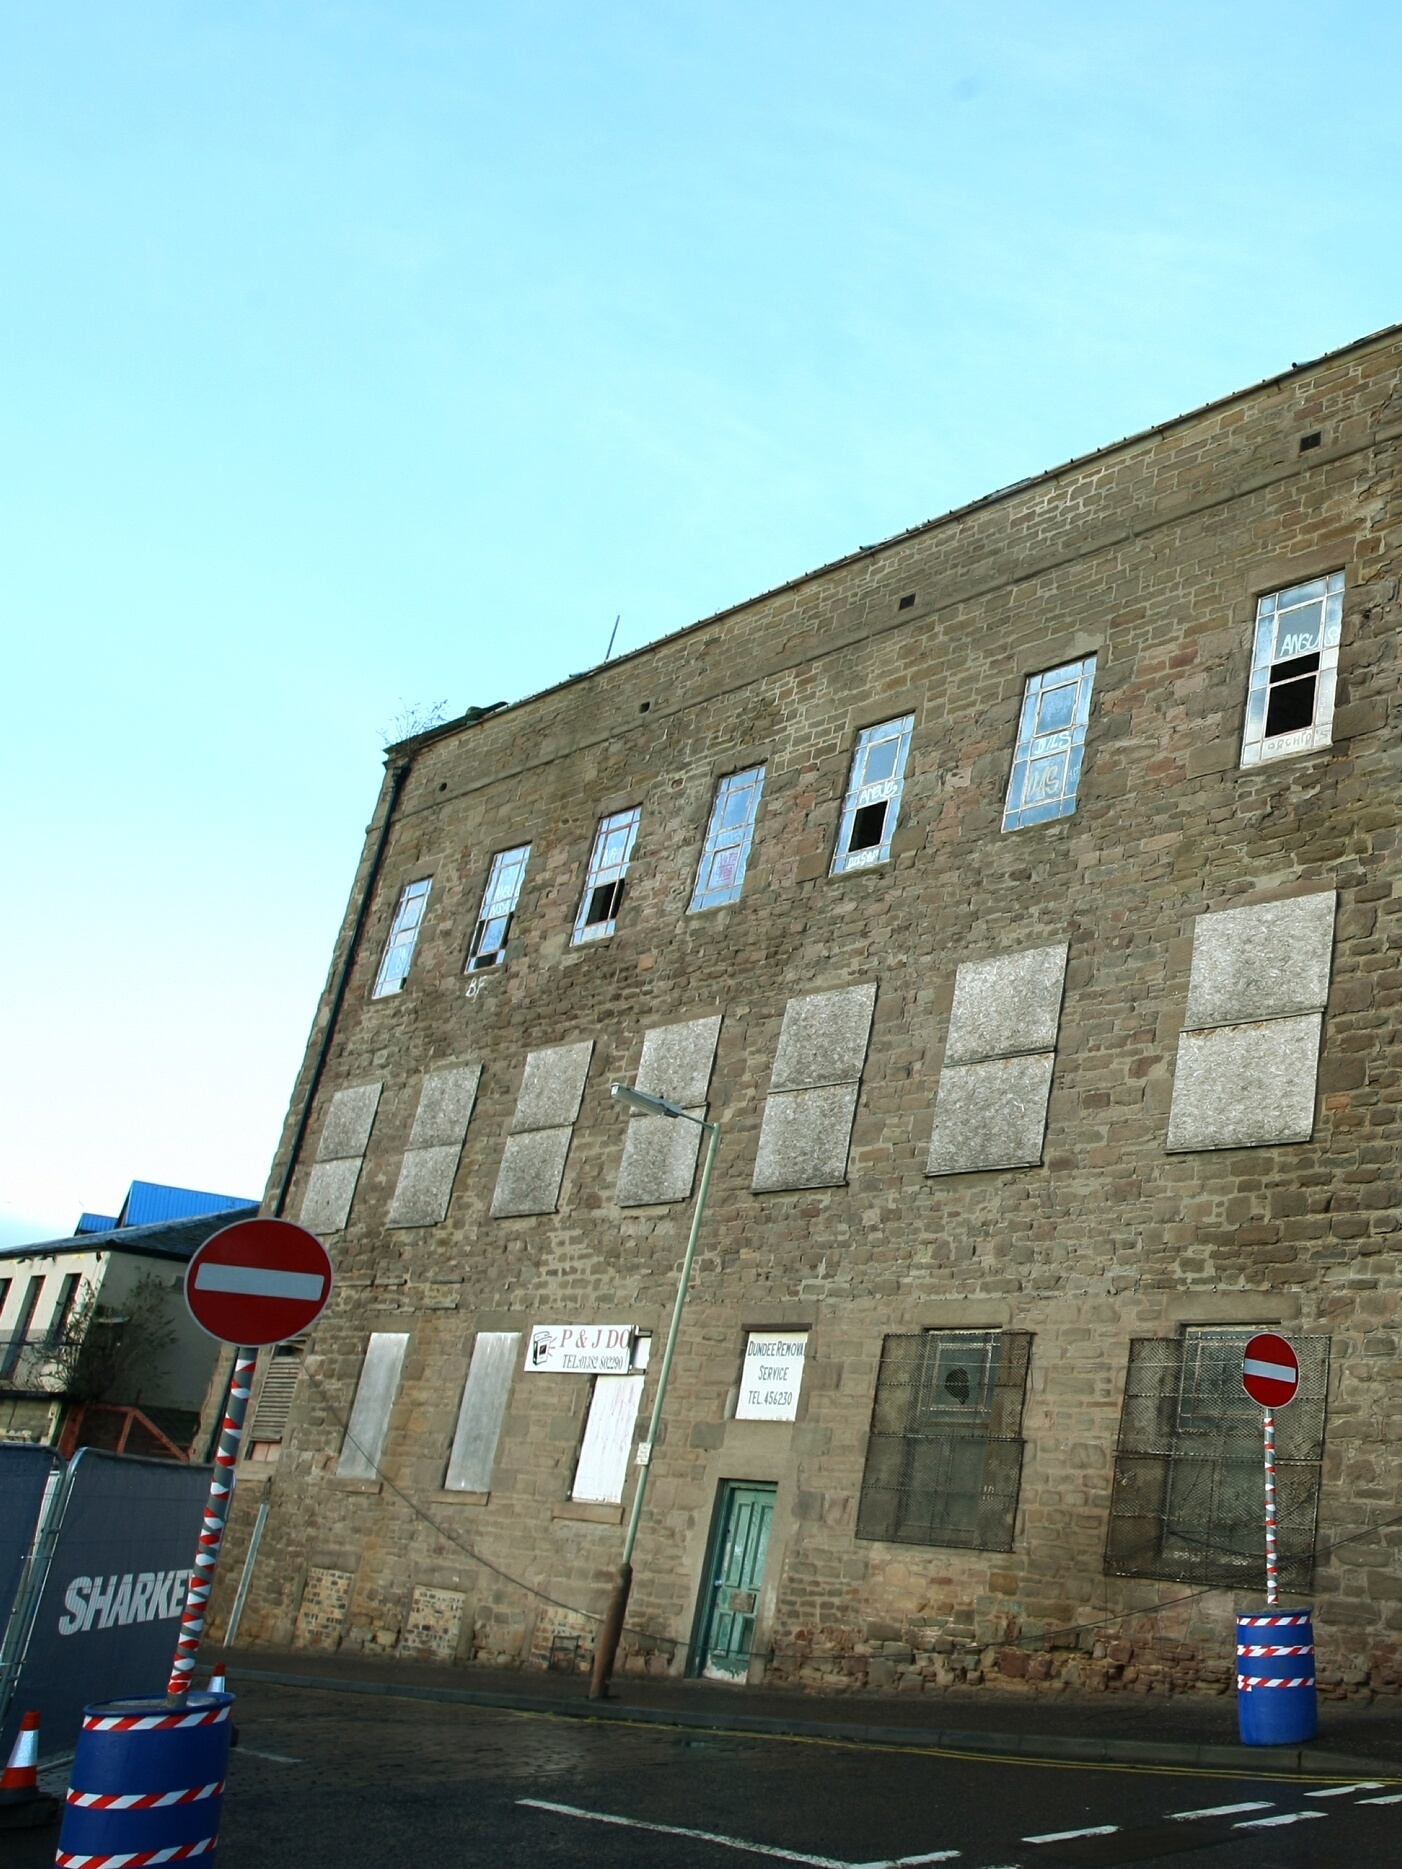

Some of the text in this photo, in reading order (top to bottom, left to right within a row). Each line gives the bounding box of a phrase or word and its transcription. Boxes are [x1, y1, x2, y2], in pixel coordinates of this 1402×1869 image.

[1280, 625, 1340, 656] ANGUS
[559, 1329, 573, 1348] P
[575, 1329, 588, 1349] &
[591, 1329, 603, 1349] J
[748, 1340, 777, 1356] DUNDEE
[758, 1365, 789, 1381] SERVICE
[764, 1391, 793, 1406] 456230
[58, 1569, 195, 1636] SHARKE
